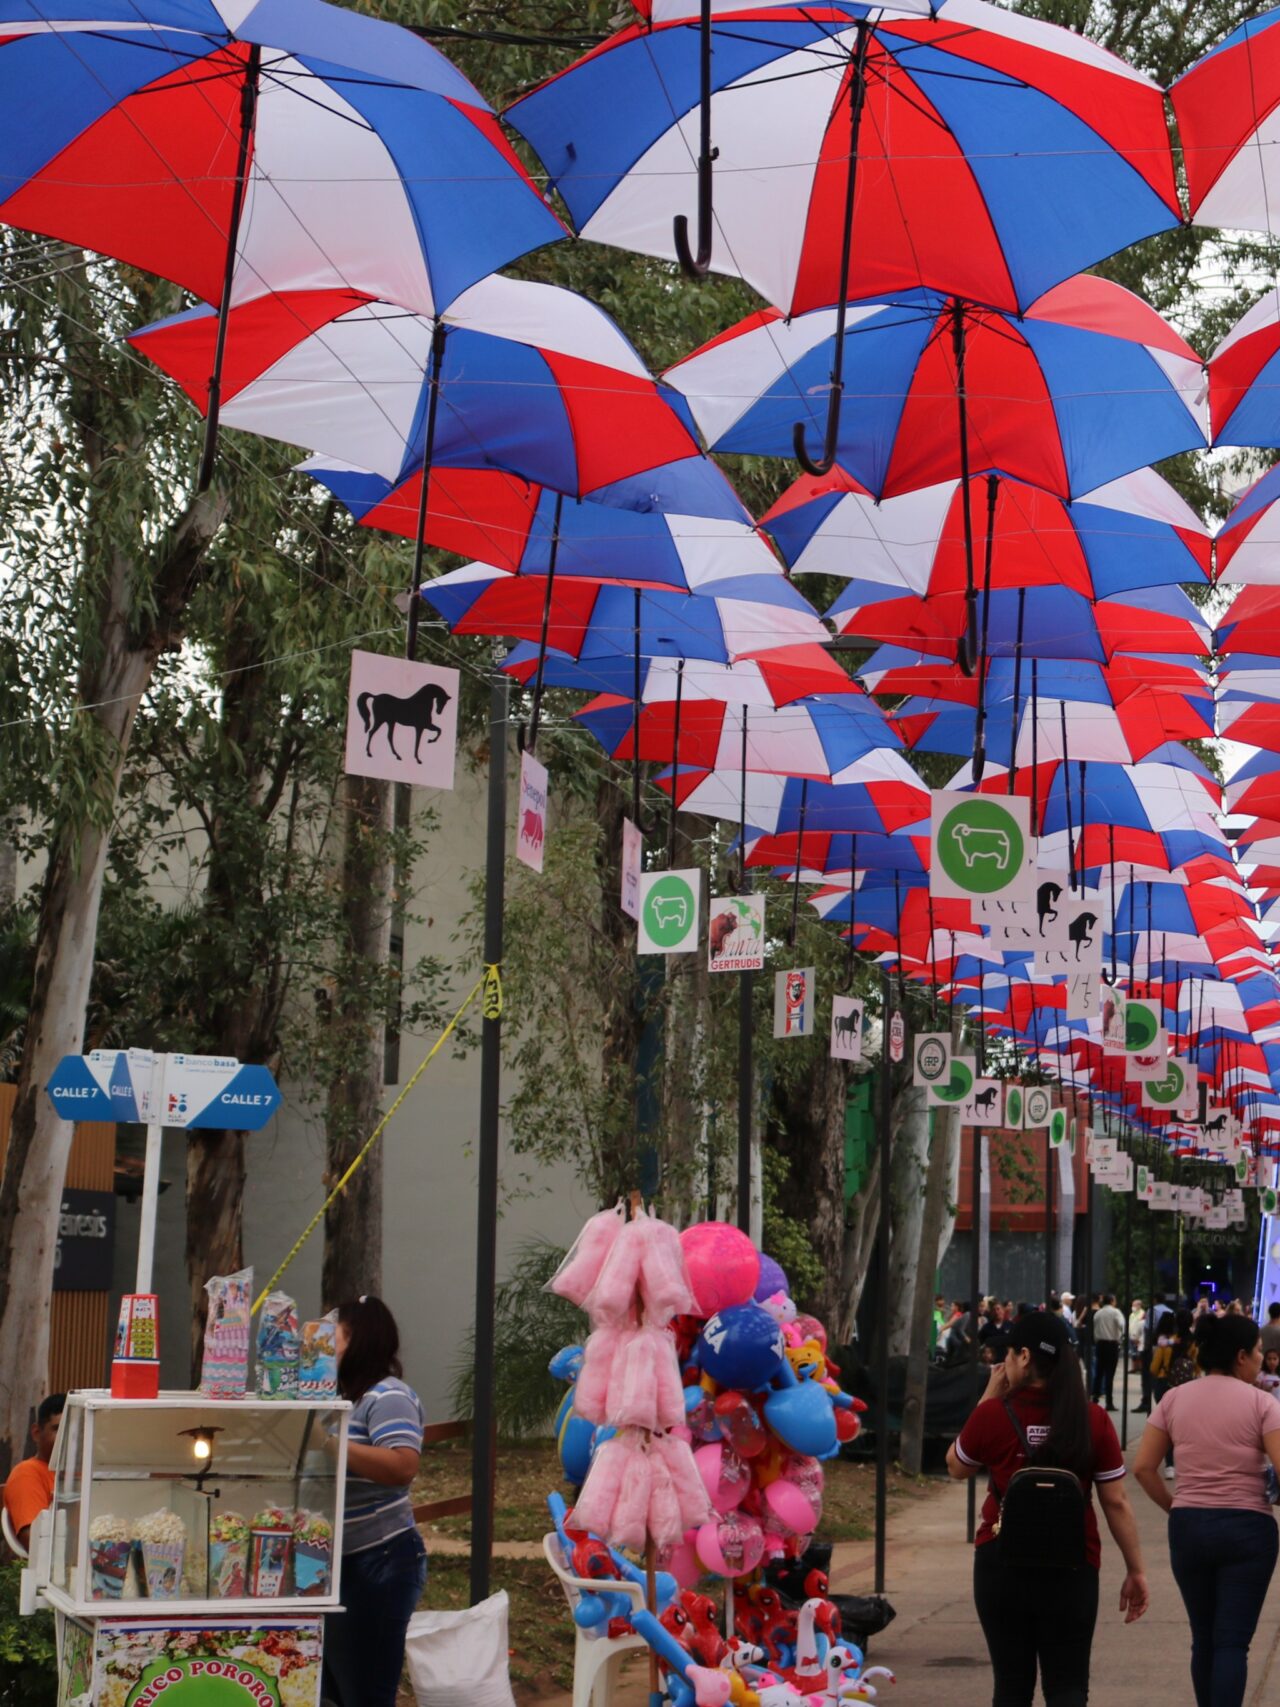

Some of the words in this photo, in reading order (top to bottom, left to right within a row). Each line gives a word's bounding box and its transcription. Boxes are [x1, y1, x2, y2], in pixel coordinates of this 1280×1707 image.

[711, 958, 761, 970] GERTRUDIS
[185, 1058, 213, 1066] banco
[213, 1058, 236, 1067] basa
[53, 1087, 89, 1098] CALLE
[90, 1087, 99, 1098] 7
[221, 1094, 261, 1105] CALLE
[262, 1095, 273, 1106] 7
[134, 1667, 183, 1707] RICO
[190, 1661, 274, 1707] PORORO
